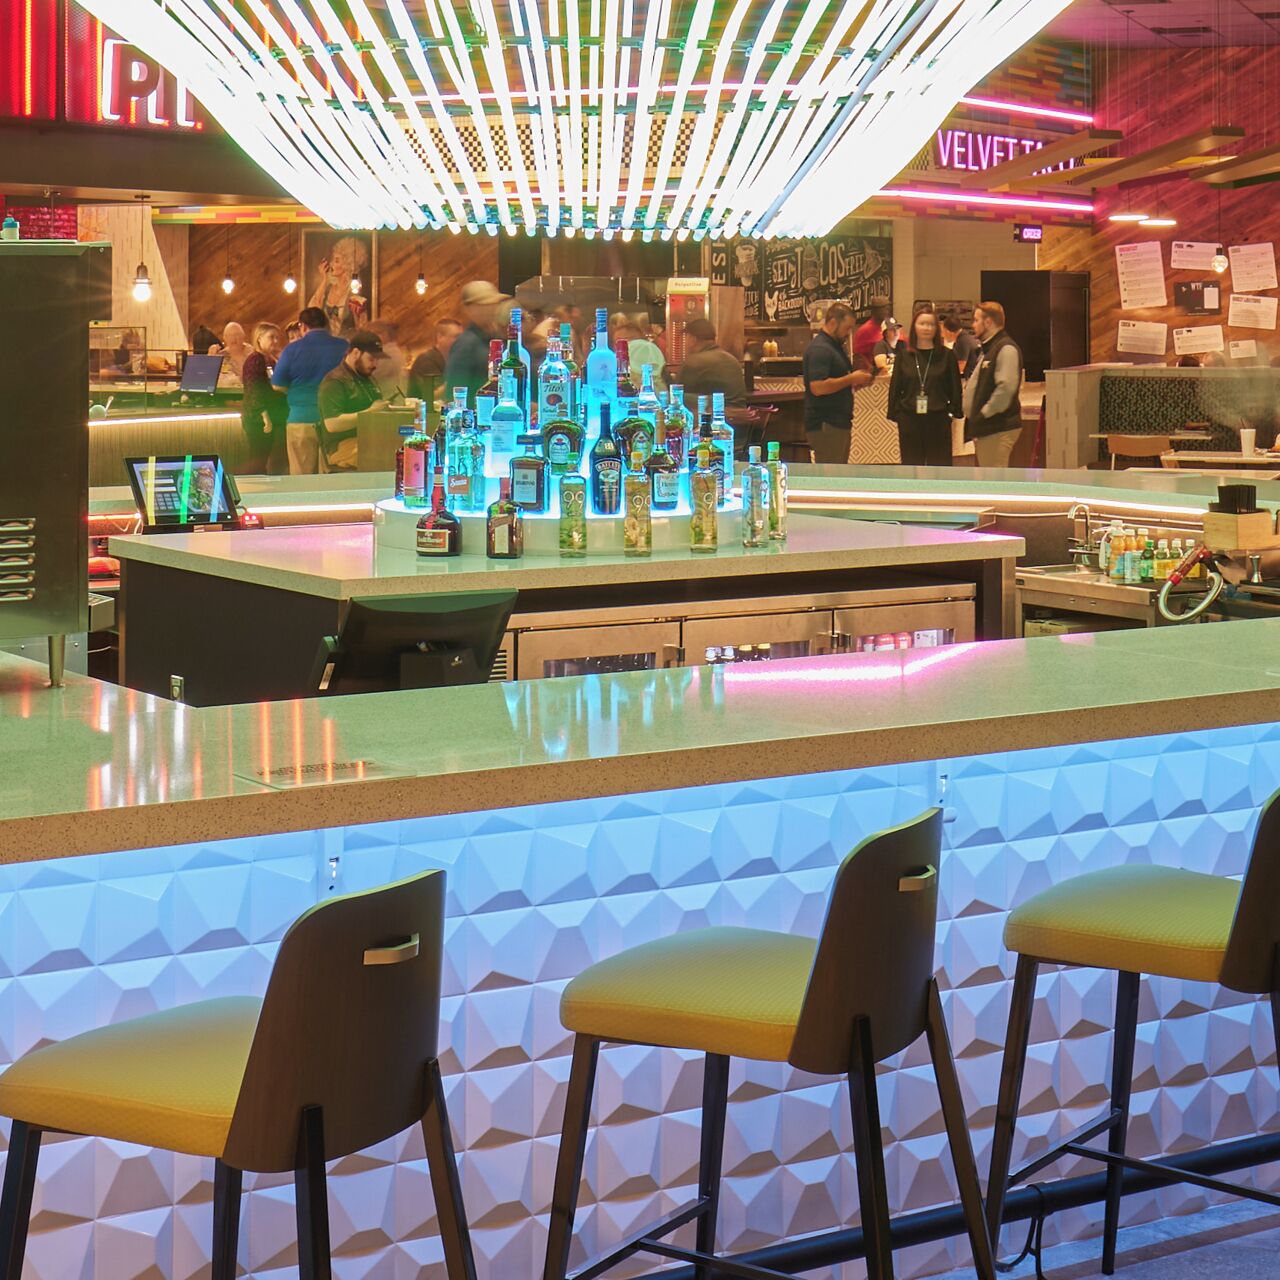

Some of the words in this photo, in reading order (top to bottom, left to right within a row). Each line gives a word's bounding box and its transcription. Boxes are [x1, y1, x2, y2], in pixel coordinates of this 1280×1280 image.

[937, 129, 1018, 171] VELVET
[543, 384, 565, 394] Tito's
[562, 490, 586, 509] 99
